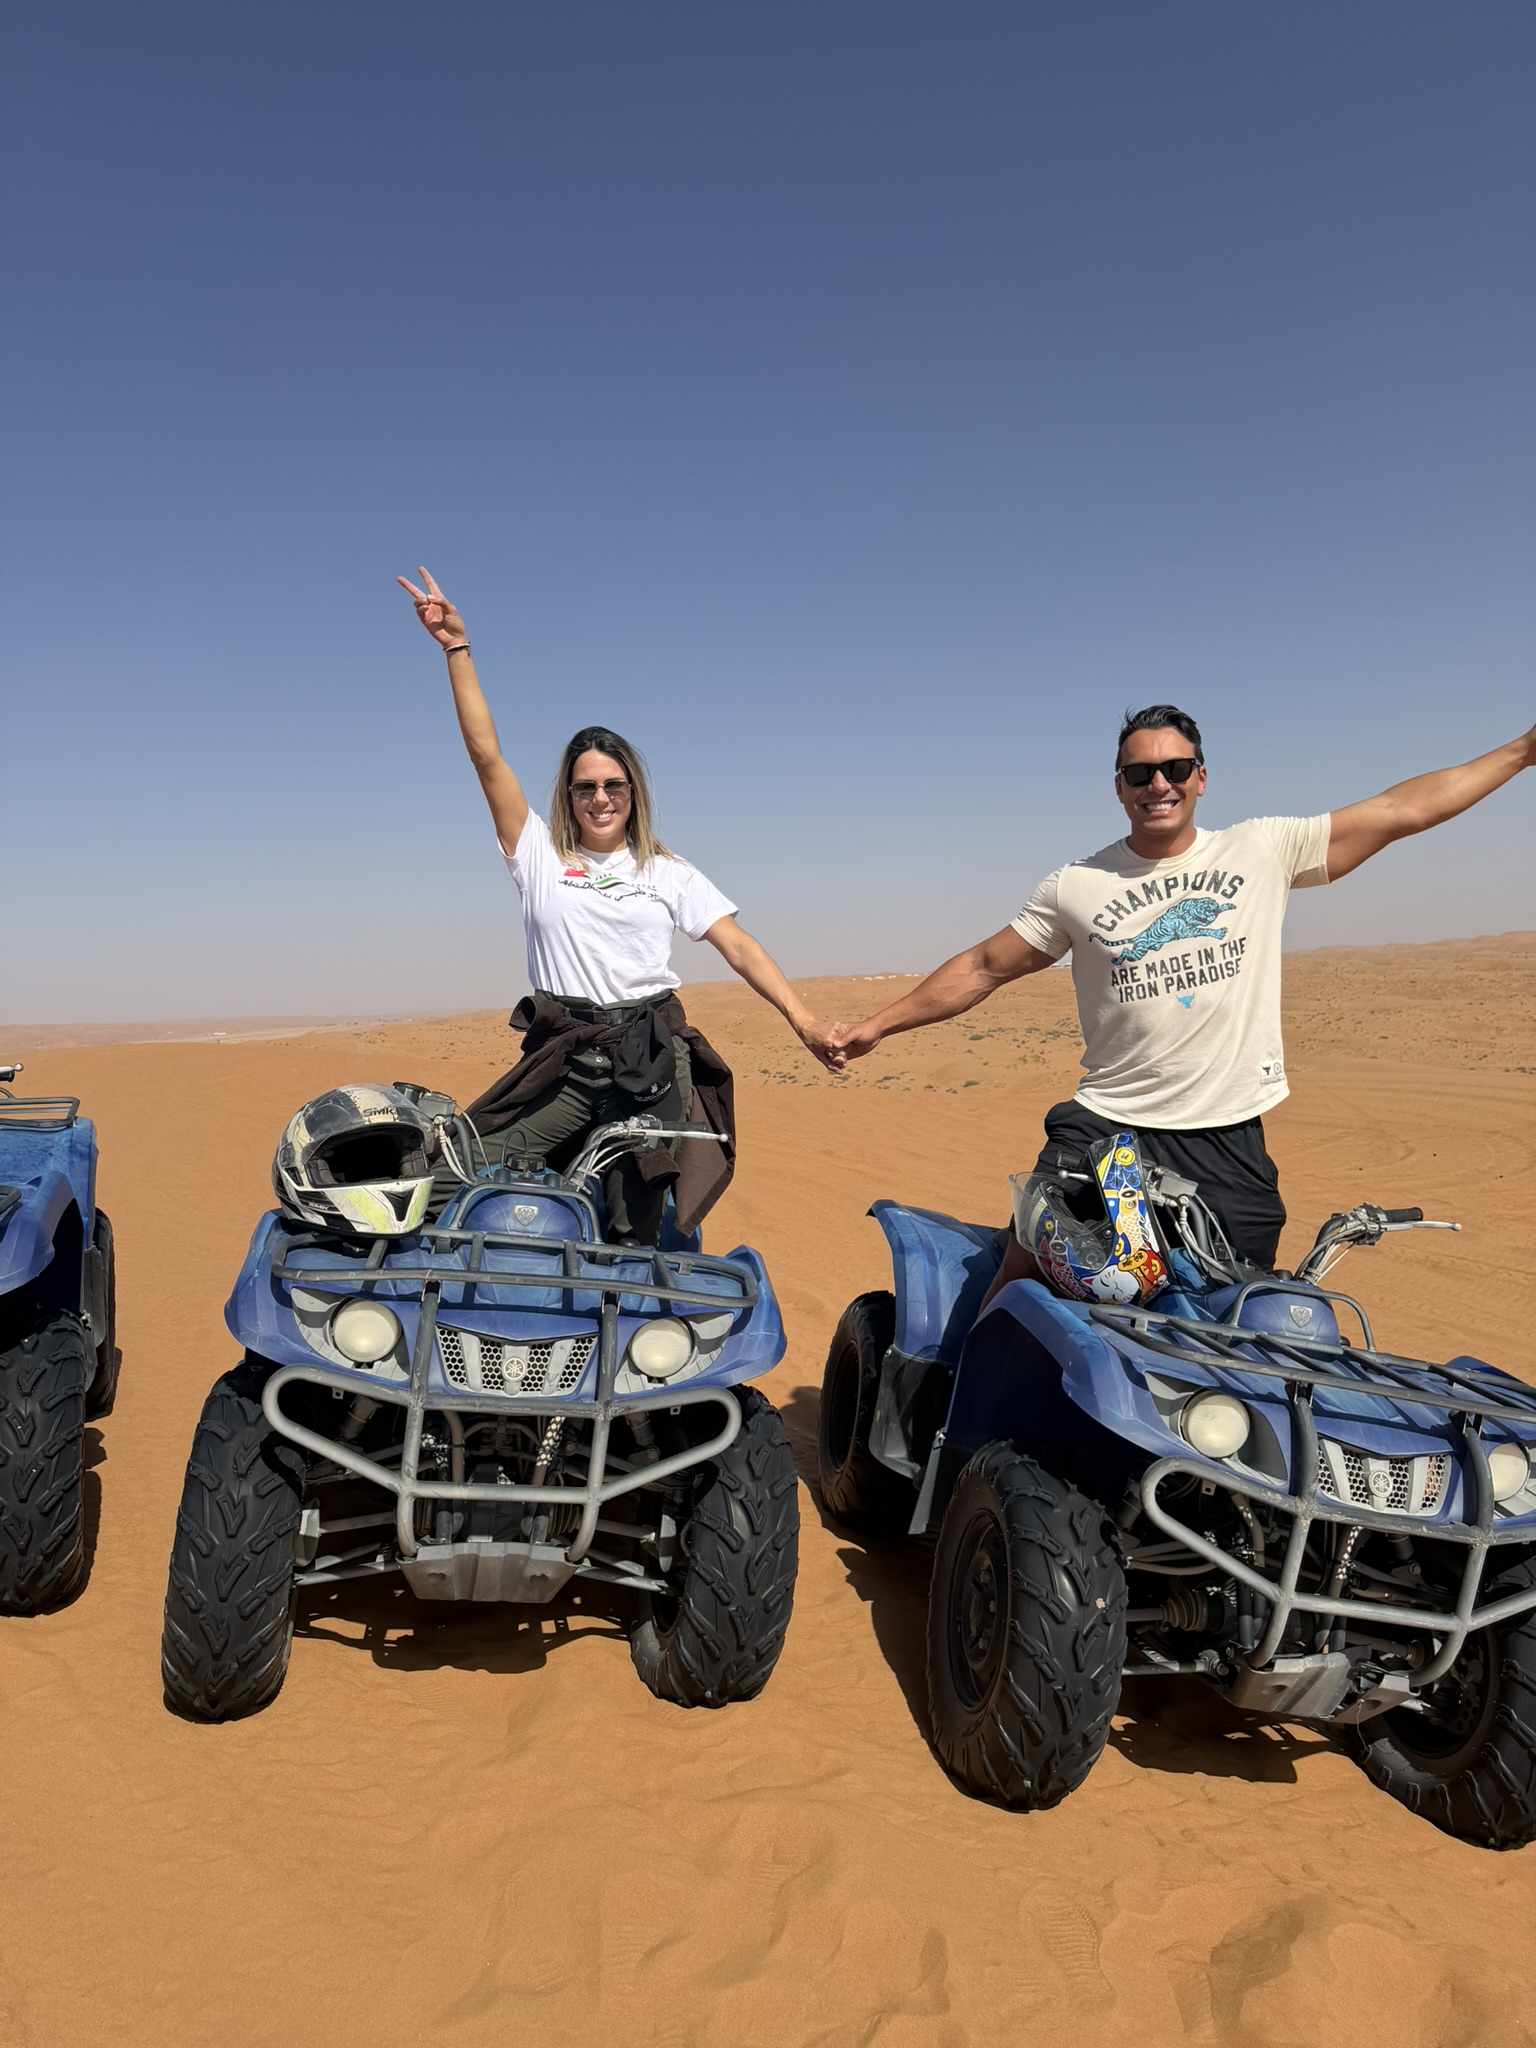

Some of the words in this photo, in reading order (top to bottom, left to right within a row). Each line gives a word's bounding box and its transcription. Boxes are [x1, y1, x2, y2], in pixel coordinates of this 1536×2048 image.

[1093, 870, 1244, 932] CHAMPIONS
[1111, 966, 1141, 987] ARE
[1145, 953, 1193, 979] MADE
[1198, 948, 1214, 967] IN
[1220, 937, 1246, 958] THE
[1119, 982, 1159, 1003] IRON
[1166, 958, 1241, 994] PARADISE
[363, 1106, 395, 1118] SMK
